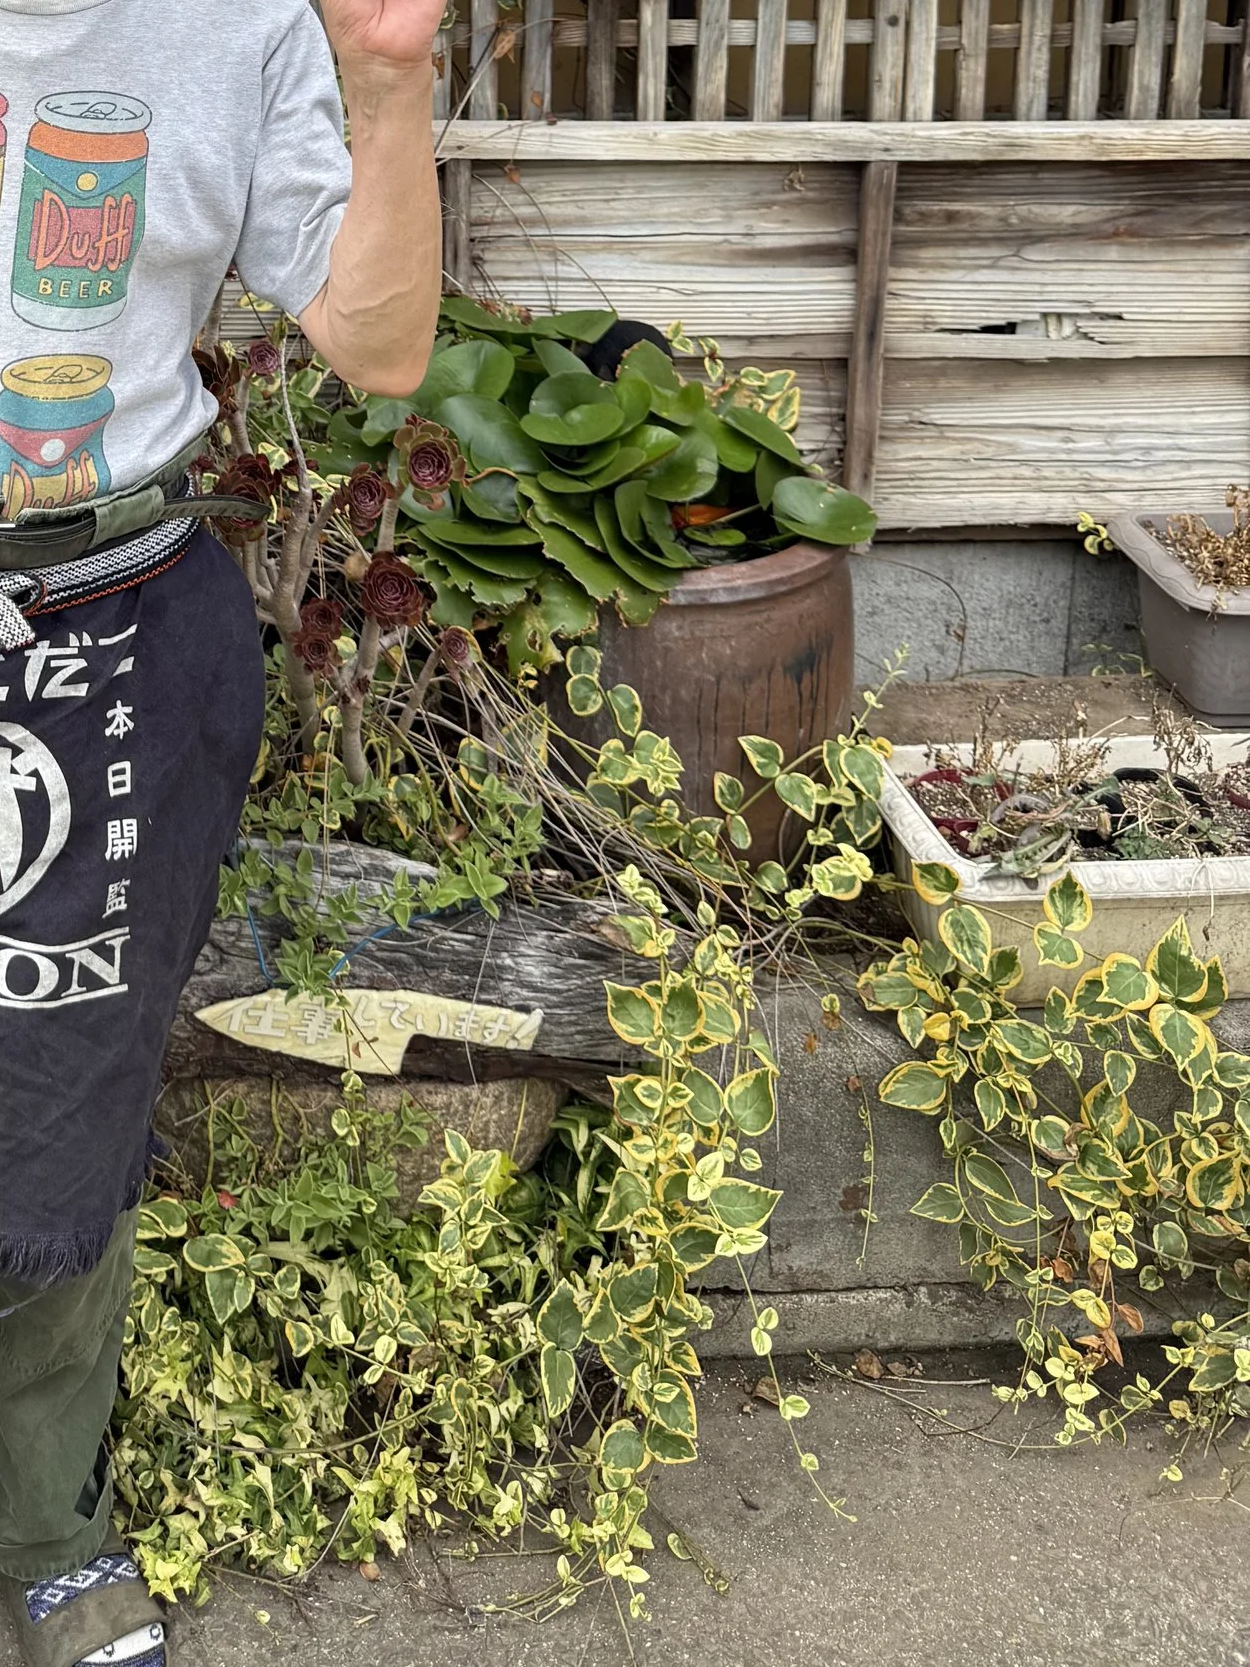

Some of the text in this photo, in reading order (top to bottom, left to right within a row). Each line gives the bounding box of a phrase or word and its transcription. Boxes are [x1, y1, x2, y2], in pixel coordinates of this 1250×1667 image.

[34, 189, 138, 272] Duff
[38, 278, 113, 298] BEER
[101, 699, 138, 919] 本日開監
